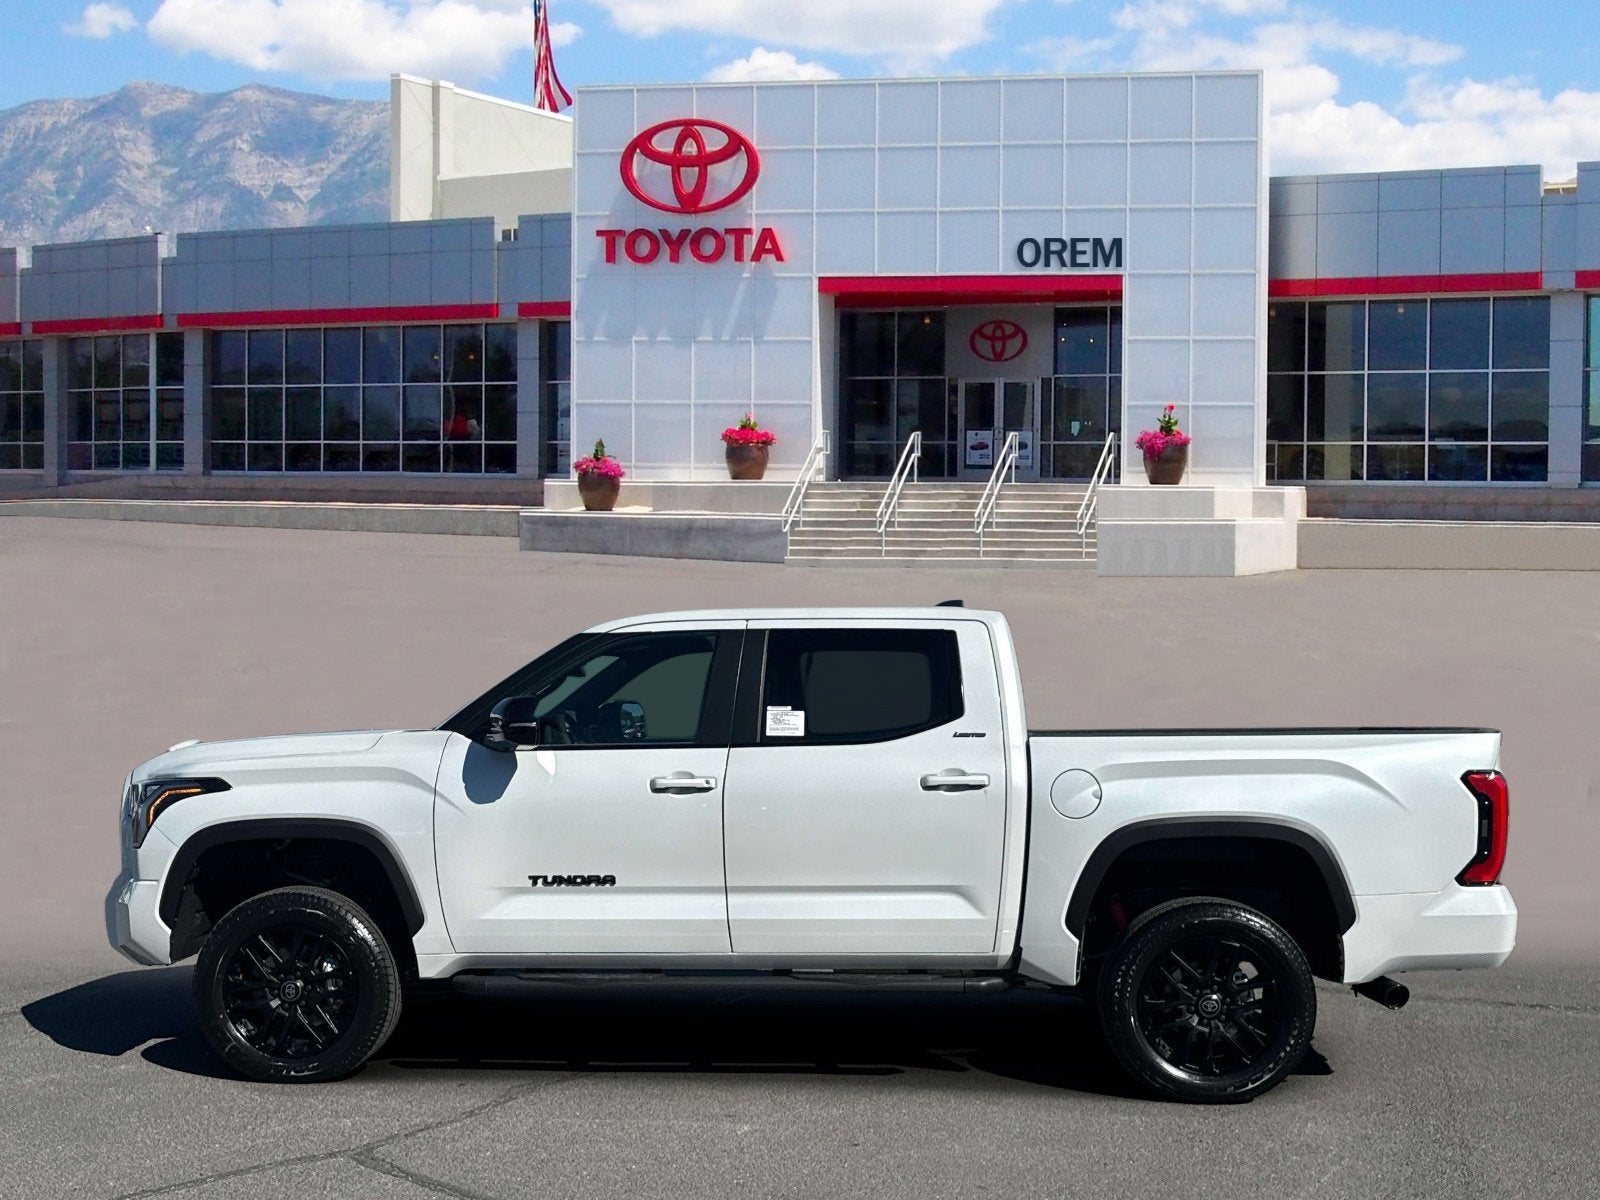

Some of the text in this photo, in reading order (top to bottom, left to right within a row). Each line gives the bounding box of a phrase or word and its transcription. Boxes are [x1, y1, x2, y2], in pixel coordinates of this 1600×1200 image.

[596, 227, 784, 264] TOYOTA
[1017, 237, 1122, 268] OREM
[528, 875, 616, 887] TUNDRA
